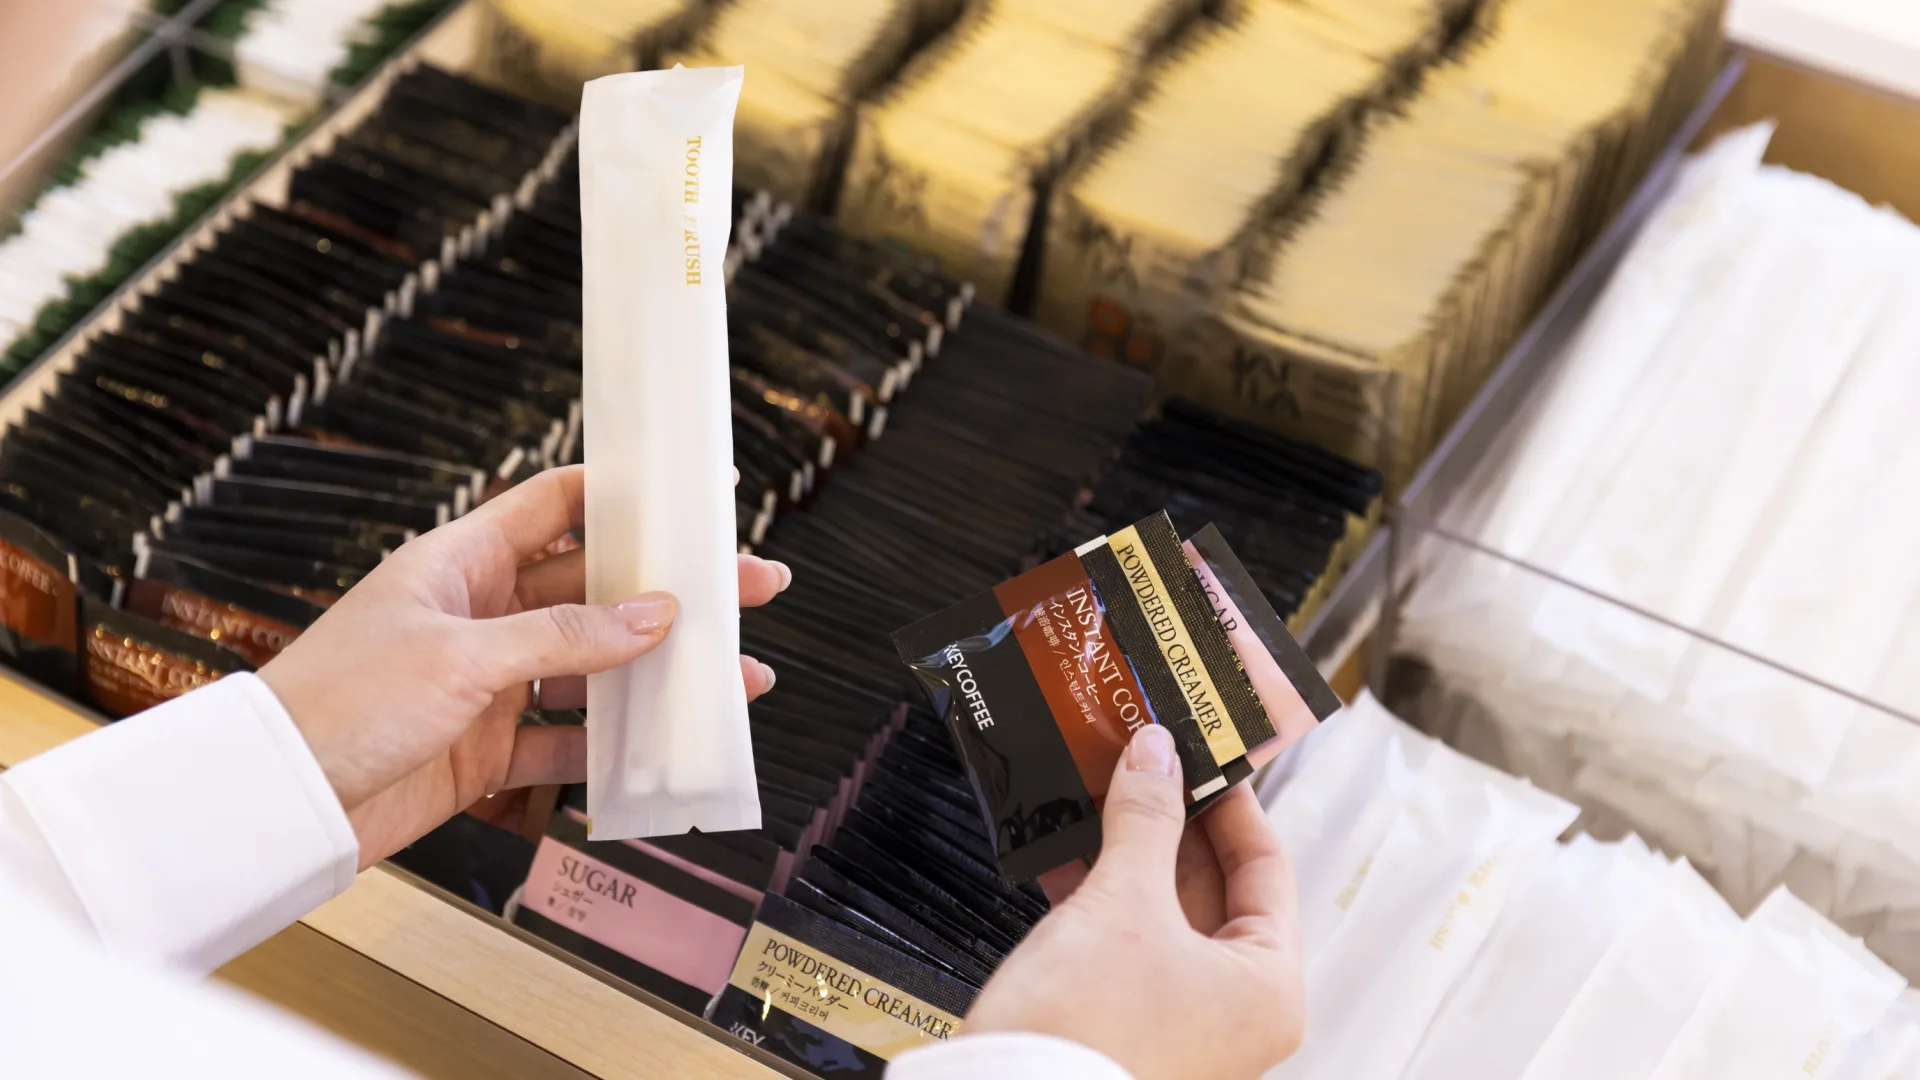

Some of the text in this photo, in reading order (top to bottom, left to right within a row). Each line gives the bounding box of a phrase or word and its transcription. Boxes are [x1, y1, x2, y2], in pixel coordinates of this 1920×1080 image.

[685, 136, 701, 204] TOOTH
[1049, 601, 1100, 705] インスタントコーヒー
[1066, 587, 1124, 685] INSTANT
[1117, 542, 1222, 736] POWDERED CREAMER
[1059, 658, 1097, 724] 인스턴트커피
[557, 855, 637, 909] SUGAR
[763, 938, 952, 1041] POWDERED CREAMER
[781, 991, 829, 1021] 커피크리머
